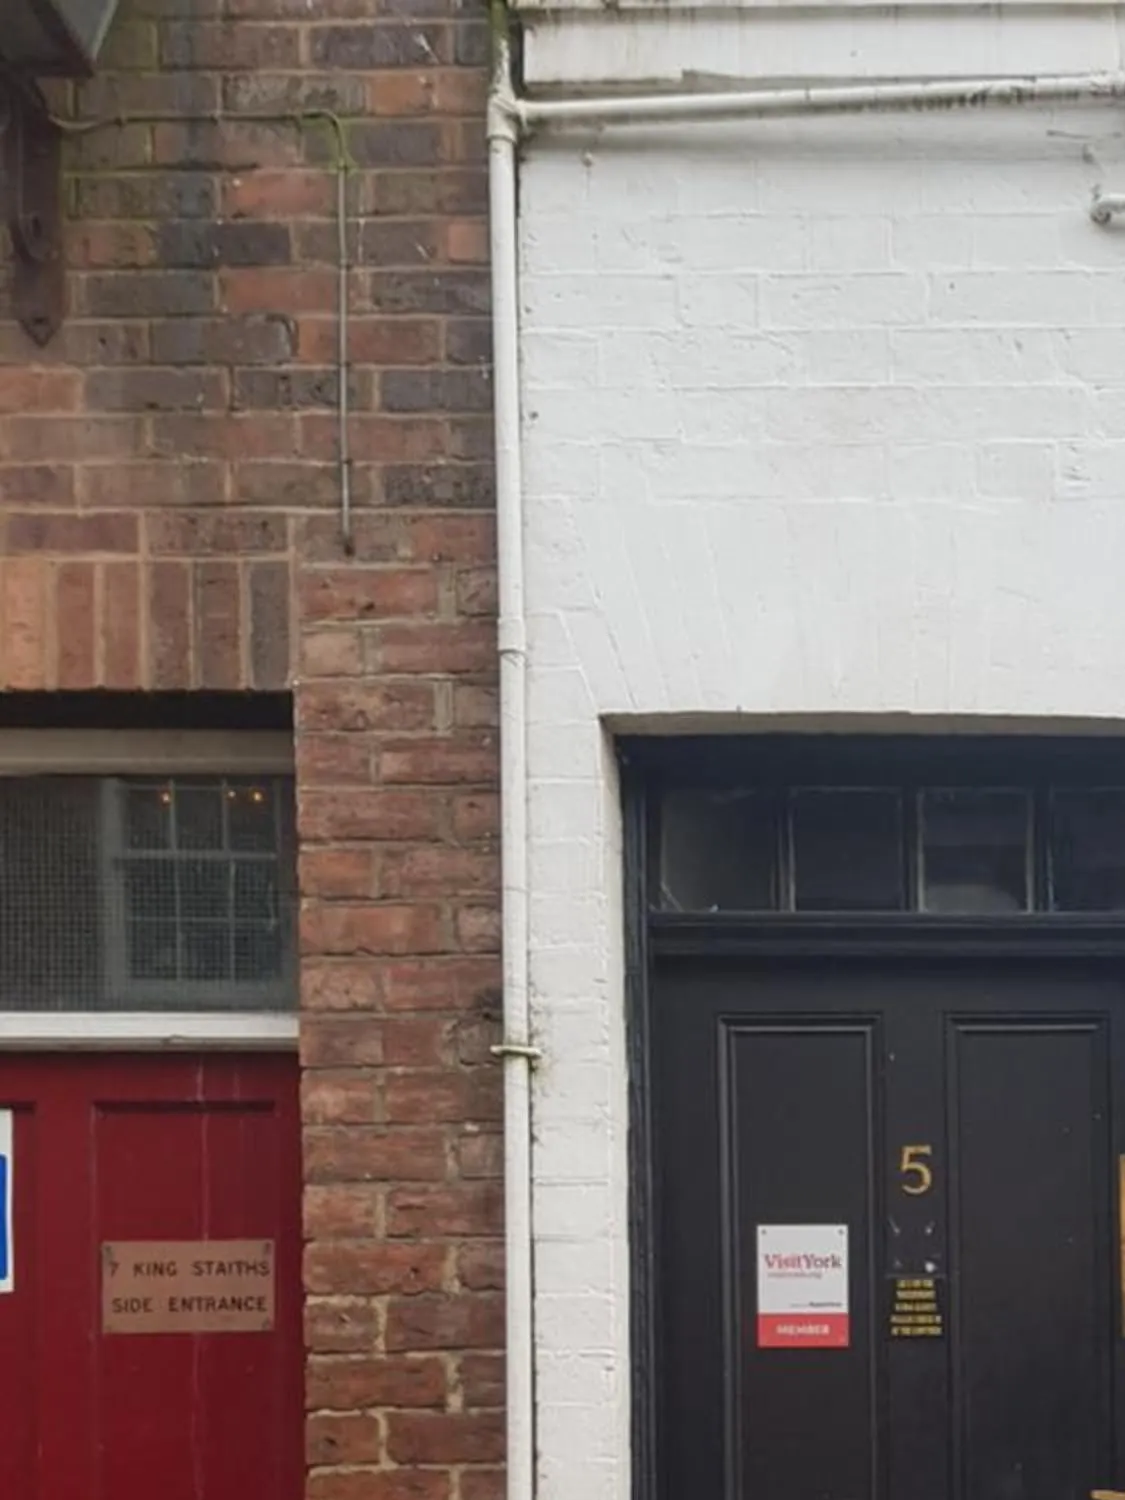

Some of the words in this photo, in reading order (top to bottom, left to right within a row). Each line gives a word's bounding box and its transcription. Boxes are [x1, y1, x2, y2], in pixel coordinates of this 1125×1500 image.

[900, 1144, 932, 1194] 5
[109, 1262, 119, 1277] 7
[132, 1261, 178, 1277] KING
[190, 1260, 271, 1277] STAITHS
[111, 1297, 154, 1313] SIDE
[168, 1296, 268, 1312] ENTRANCE
